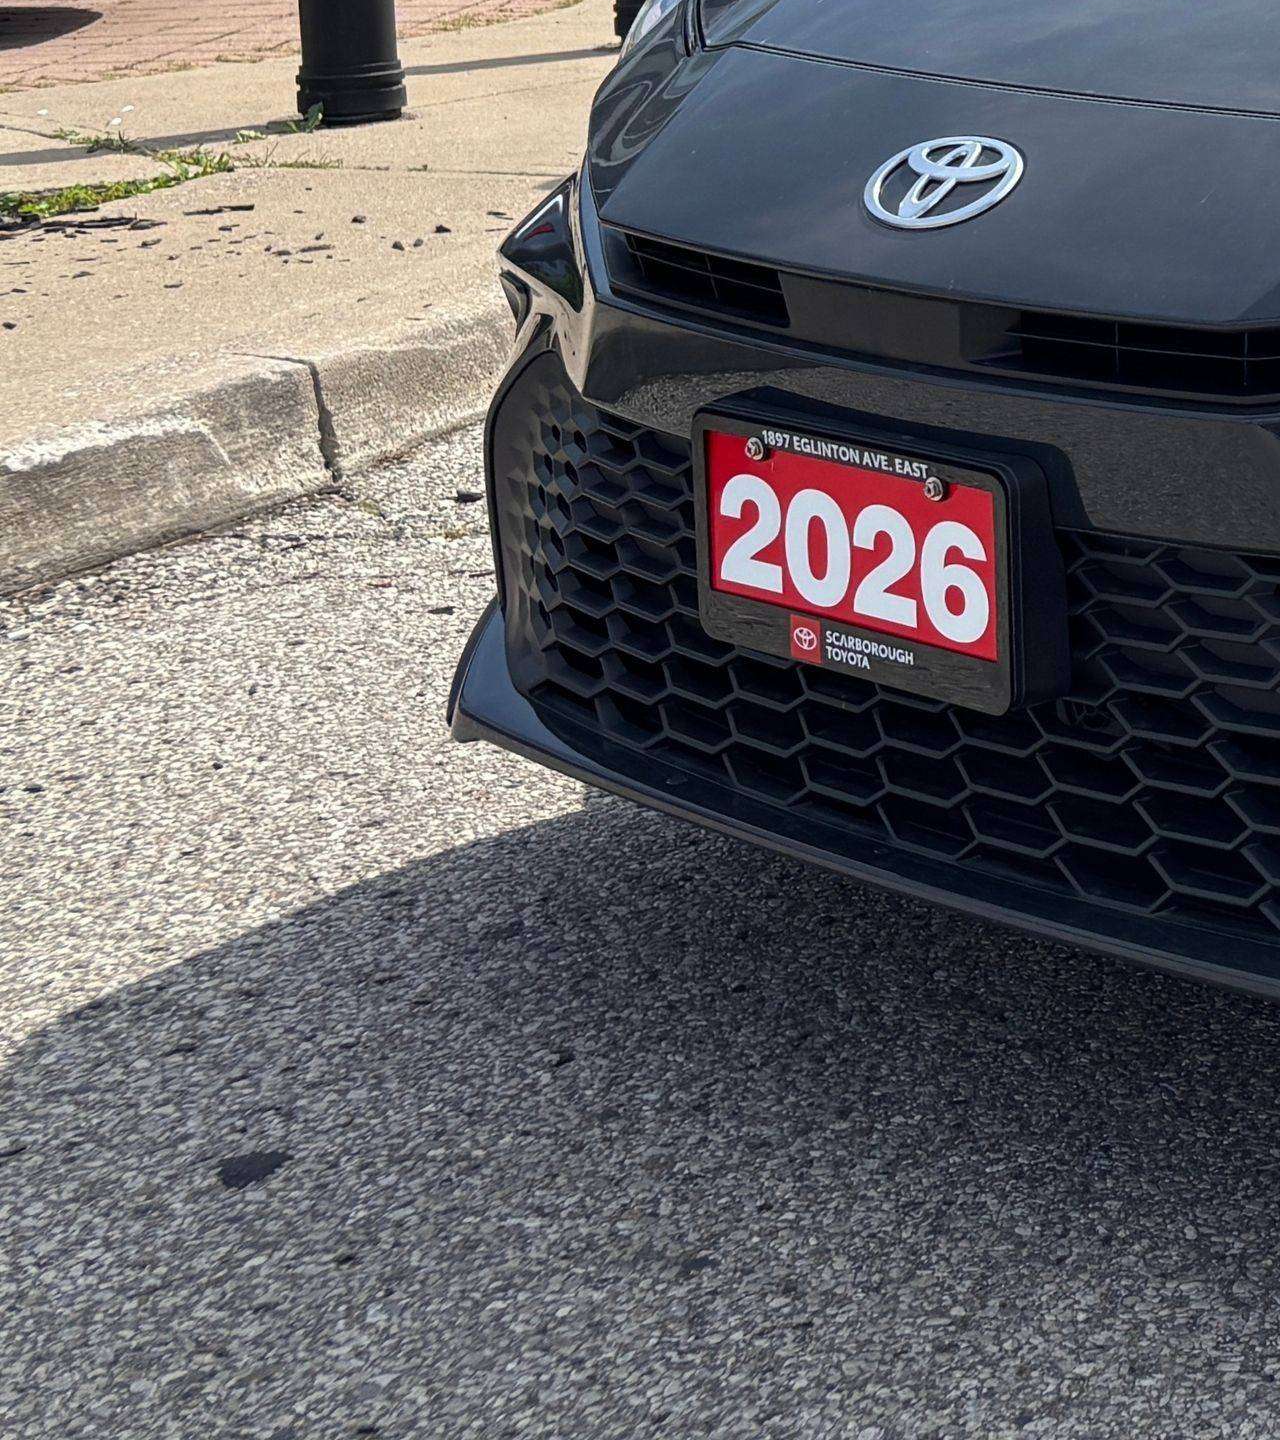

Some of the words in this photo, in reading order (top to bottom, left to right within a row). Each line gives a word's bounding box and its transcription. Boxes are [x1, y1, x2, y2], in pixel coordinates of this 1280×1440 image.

[761, 429, 790, 449] 1897
[792, 435, 861, 465] EGLINTON
[862, 452, 893, 472] AVE.
[894, 458, 929, 479] EAST
[720, 473, 990, 644] 2026
[825, 630, 915, 666] SCARBOROUGH
[825, 645, 871, 670] TOYOTA
